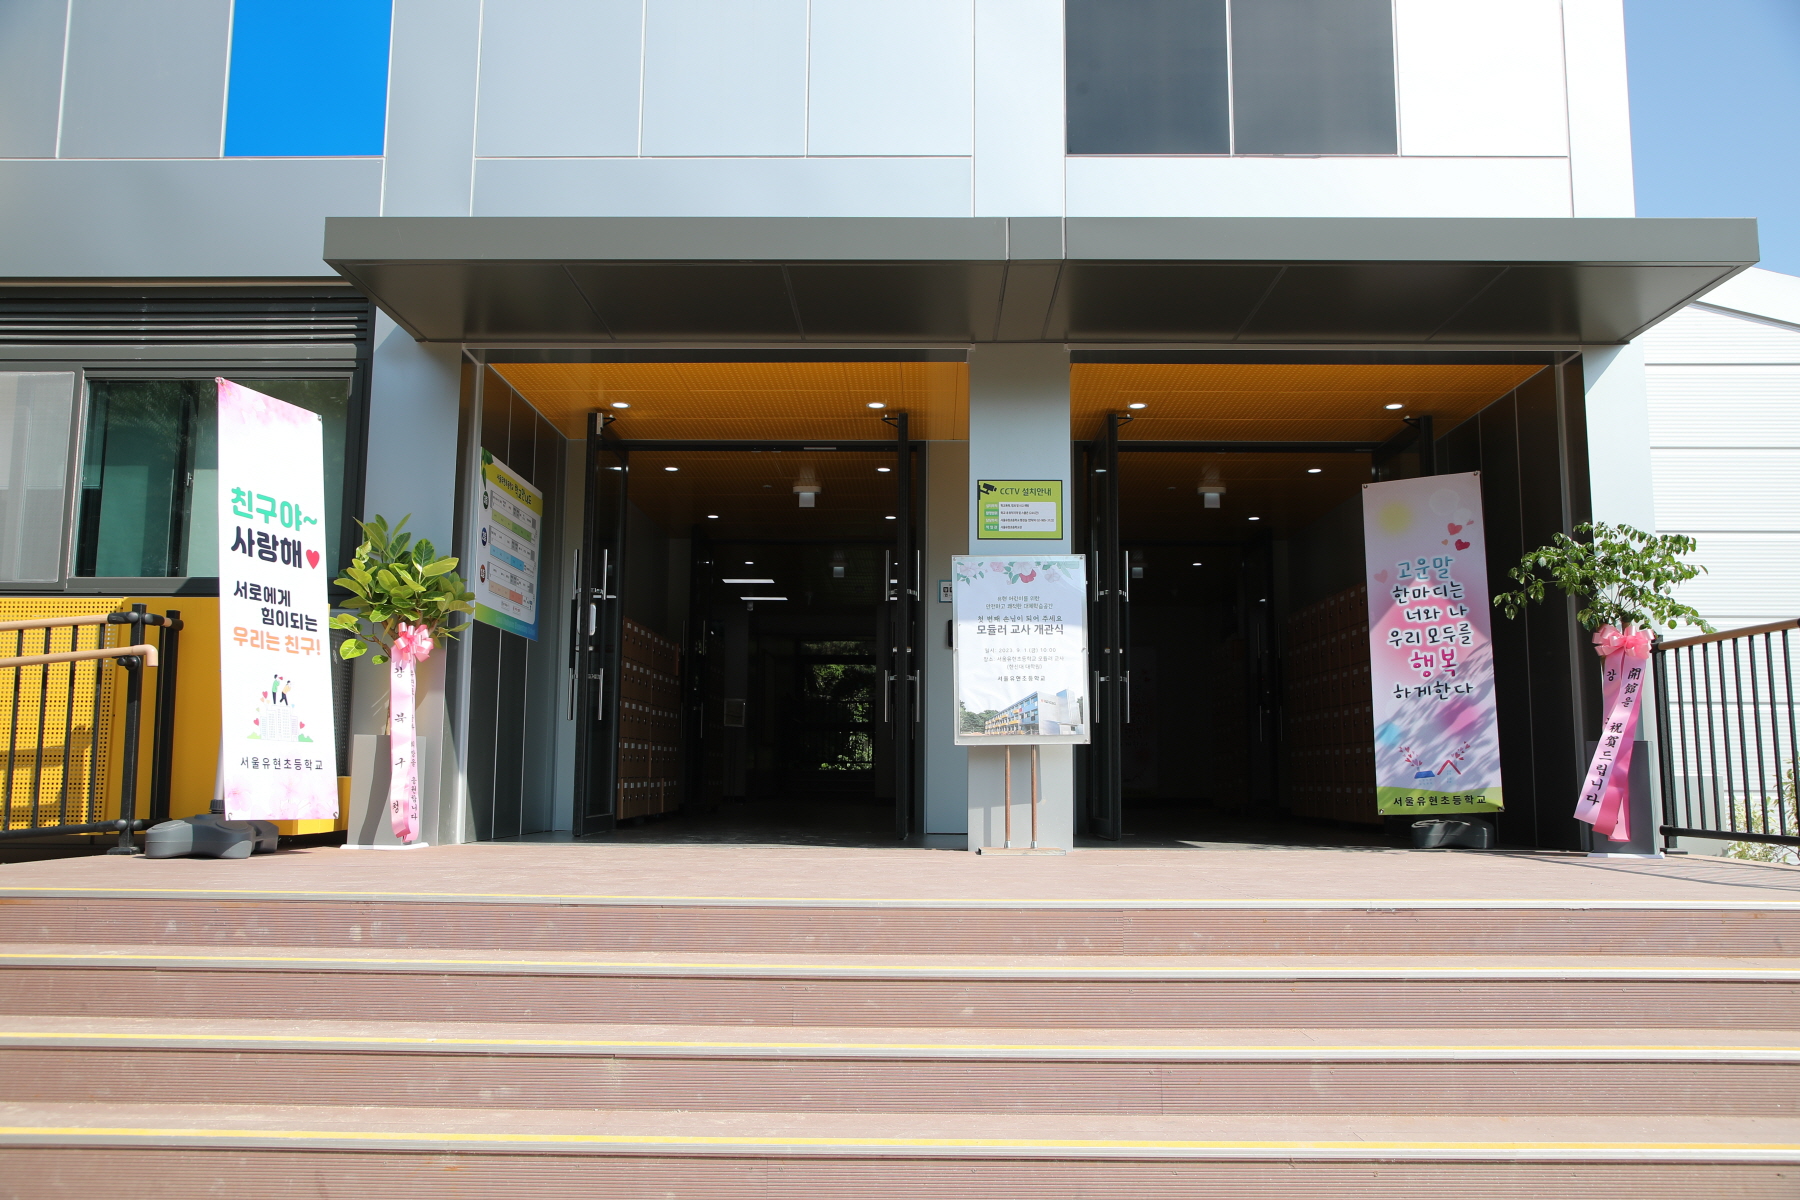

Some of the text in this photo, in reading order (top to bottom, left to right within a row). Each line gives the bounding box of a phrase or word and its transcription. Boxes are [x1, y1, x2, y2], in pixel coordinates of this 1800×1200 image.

[1000, 487, 1052, 497] CCTV 설치안내
[231, 487, 318, 532] 친구야~
[230, 526, 303, 569] 사랑해
[1396, 555, 1454, 580] 고운말
[233, 580, 291, 608] 서로에게
[1392, 580, 1464, 605] 한마디는
[261, 606, 318, 632] 힘이되는
[986, 615, 1001, 623] 번째
[1002, 614, 1024, 623] 손님이
[1025, 614, 1040, 623] 되어
[1041, 614, 1063, 623] 주세요
[1404, 603, 1468, 623] 너와 나
[233, 626, 321, 656] 우리는 친구!
[976, 624, 1064, 636] 모듈러 교사 개관식
[1387, 622, 1473, 647] 우리 모두를
[1410, 647, 1458, 678] 행복
[240, 756, 324, 771] 서울유현초등학교
[1393, 793, 1487, 808] 서울유현초등학교
